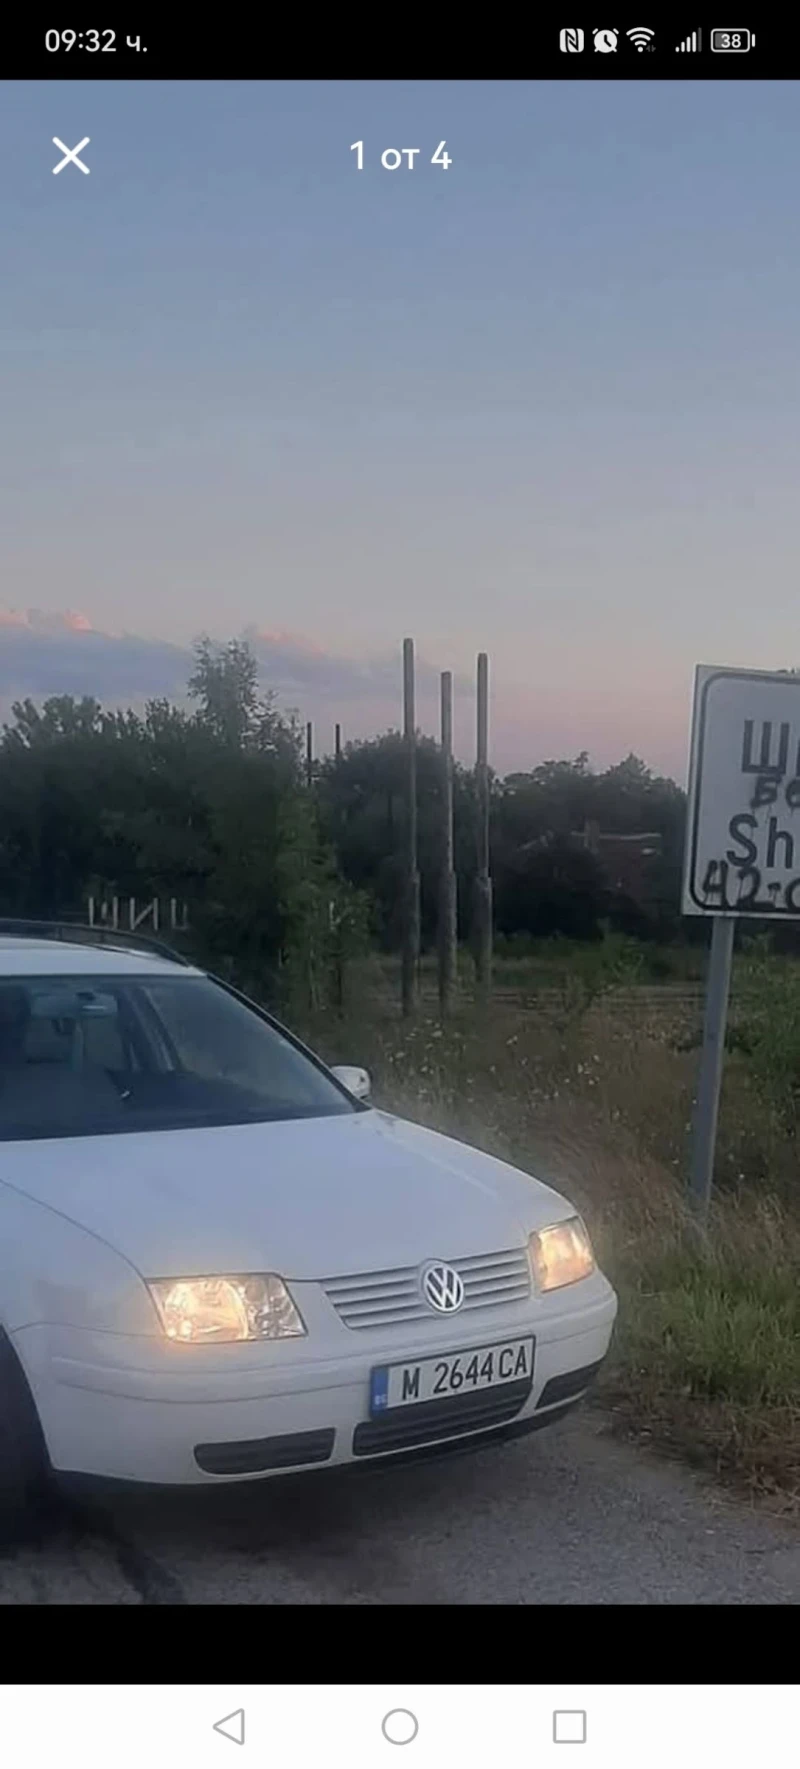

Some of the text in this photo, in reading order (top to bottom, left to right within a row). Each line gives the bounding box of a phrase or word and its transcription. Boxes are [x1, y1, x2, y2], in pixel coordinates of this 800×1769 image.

[425, 1264, 464, 1312] VW
[402, 1345, 528, 1400] M 2644 CA
